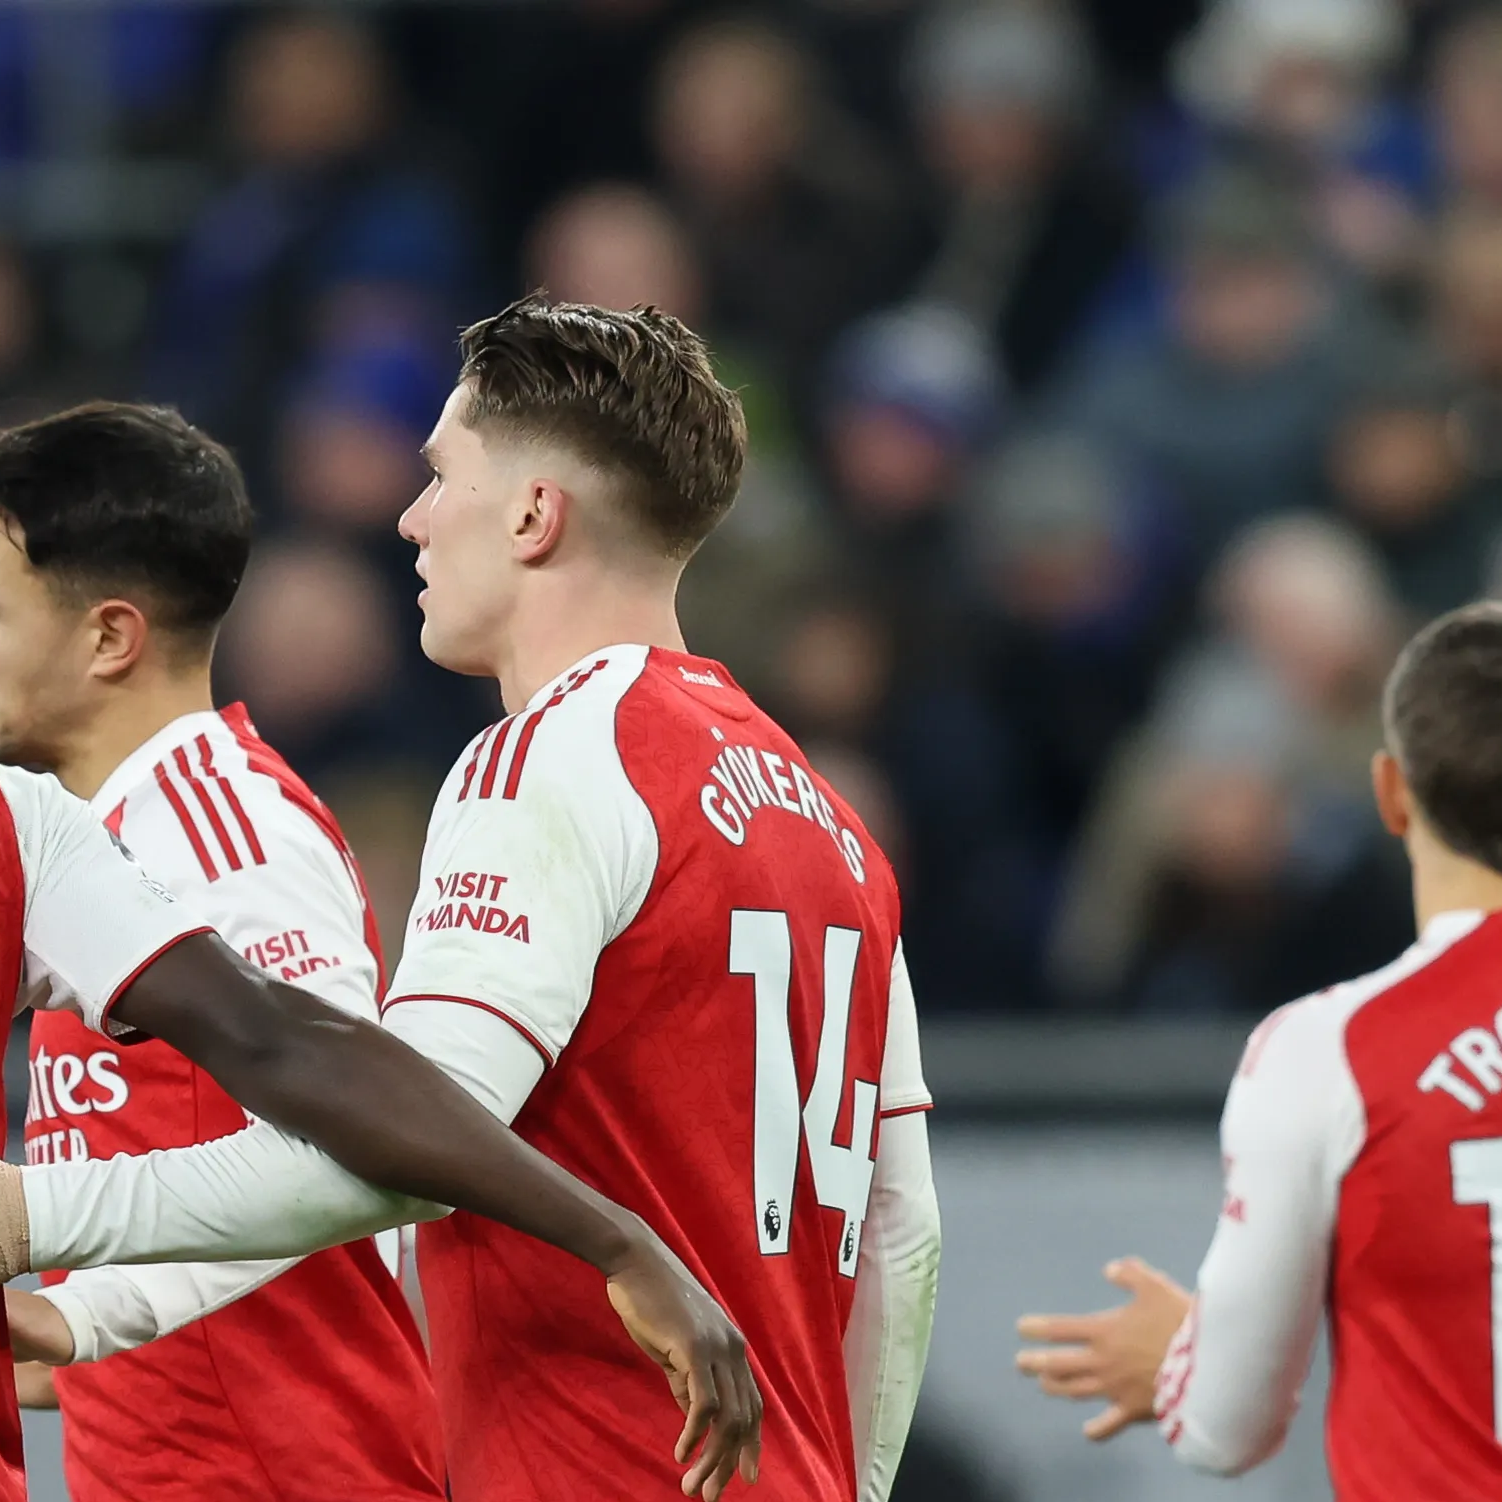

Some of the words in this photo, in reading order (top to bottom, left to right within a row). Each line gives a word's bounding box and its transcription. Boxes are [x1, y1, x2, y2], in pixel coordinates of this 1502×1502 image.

[434, 872, 509, 902] VISIT
[416, 902, 531, 944] WANDA
[727, 907, 880, 1280] 14
